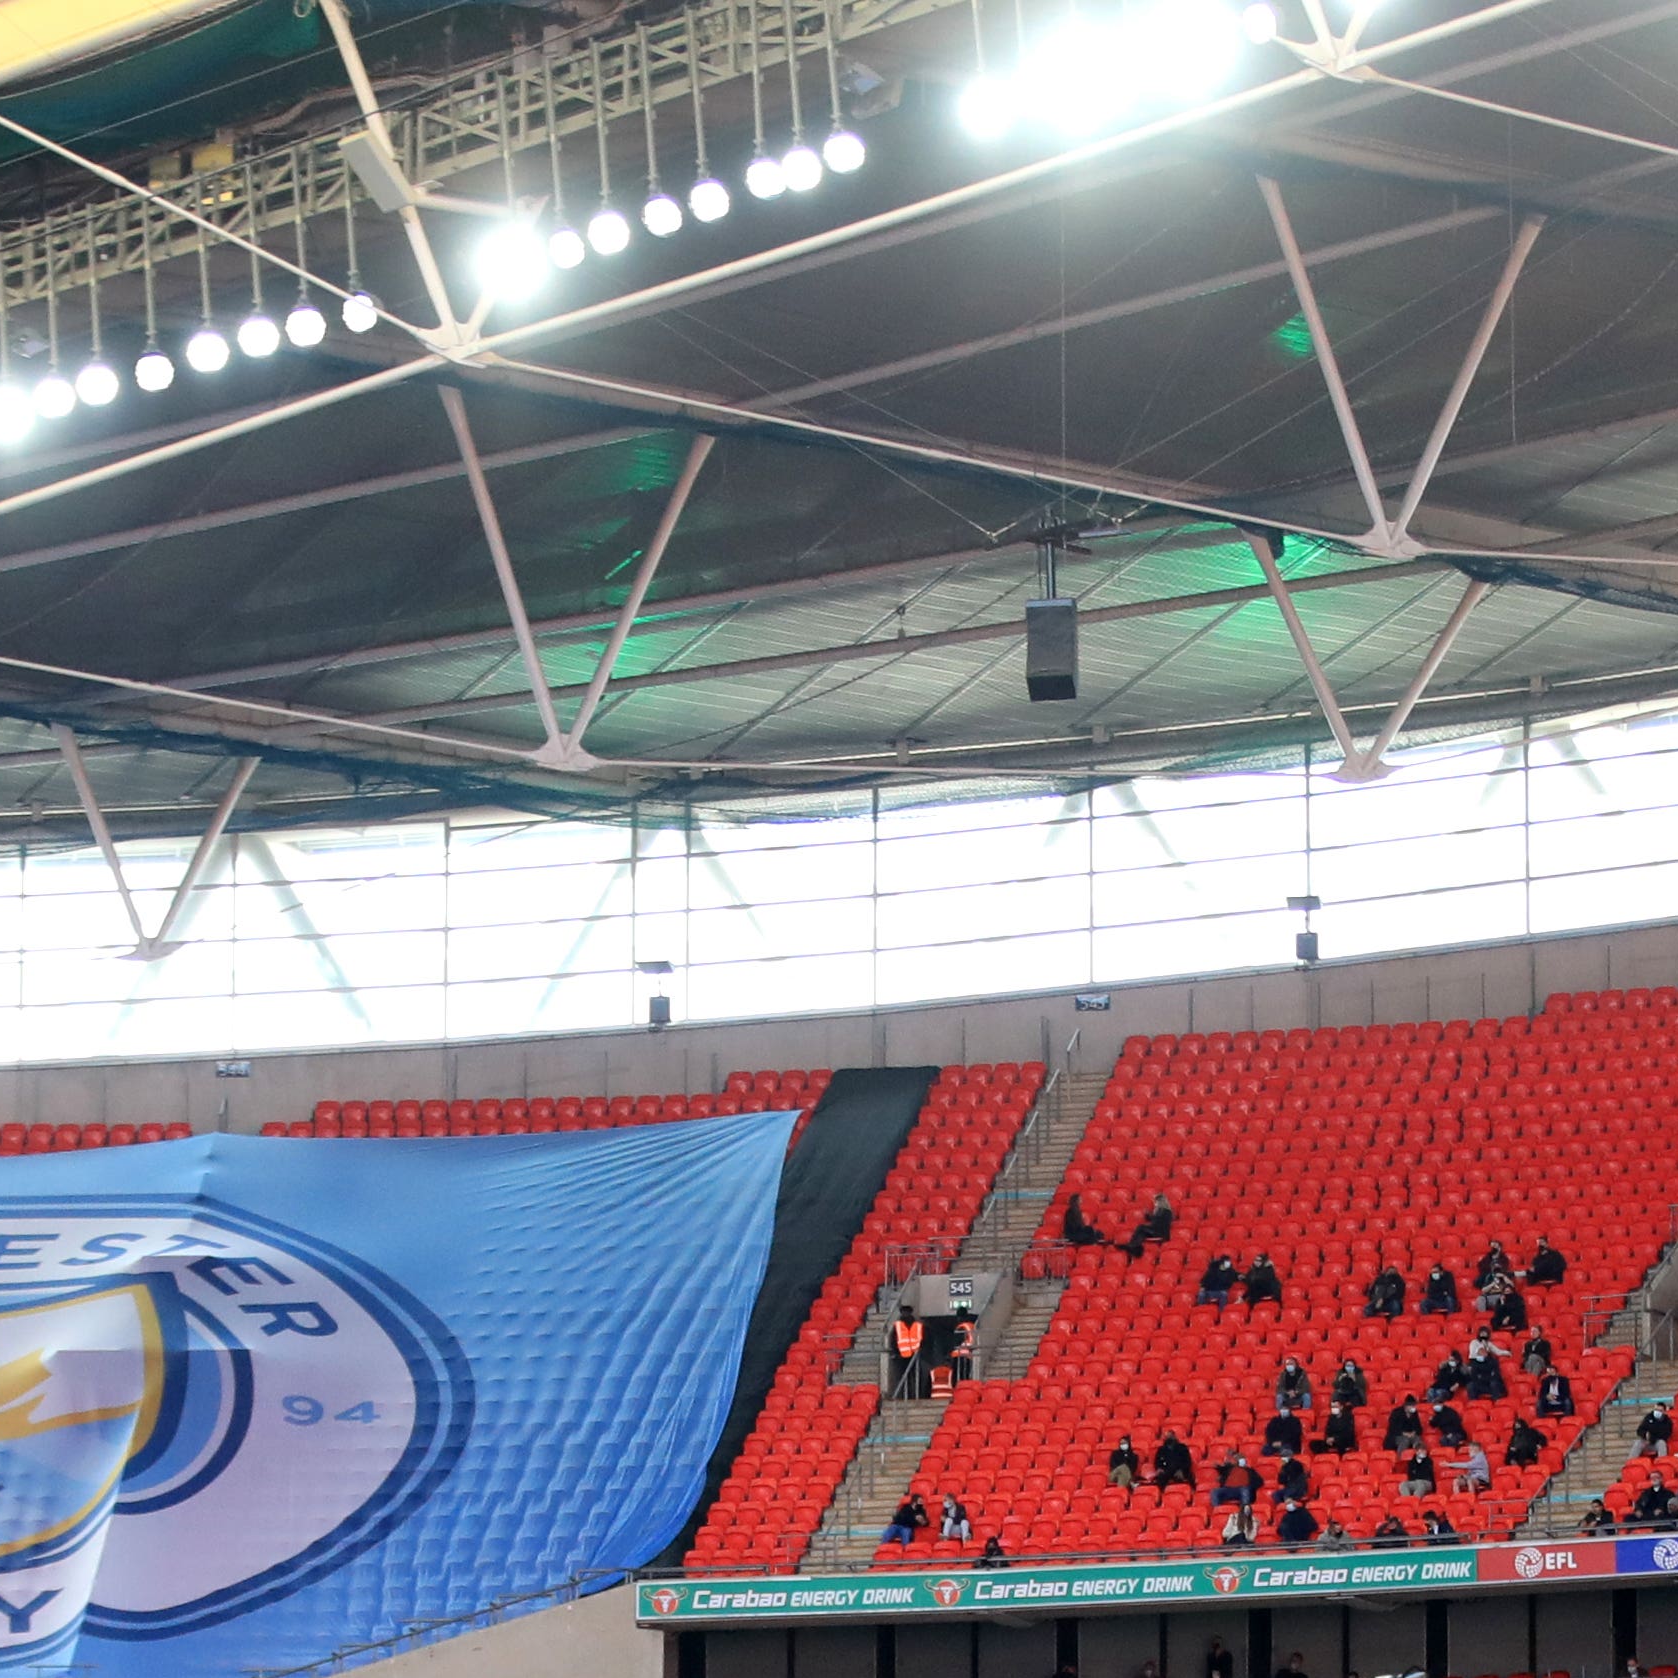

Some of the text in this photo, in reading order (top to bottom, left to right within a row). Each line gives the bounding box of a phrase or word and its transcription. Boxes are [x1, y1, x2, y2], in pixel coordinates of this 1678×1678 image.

[950, 1282, 972, 1294] 545
[282, 1394, 380, 1425] 94
[1546, 1552, 1576, 1569] EFL
[1254, 1562, 1471, 1586] Carabao ENERGY DRINK
[693, 1588, 914, 1608] Carabao ENERGY DRINK
[975, 1576, 1194, 1599] Carabao ENERGY DRINK
